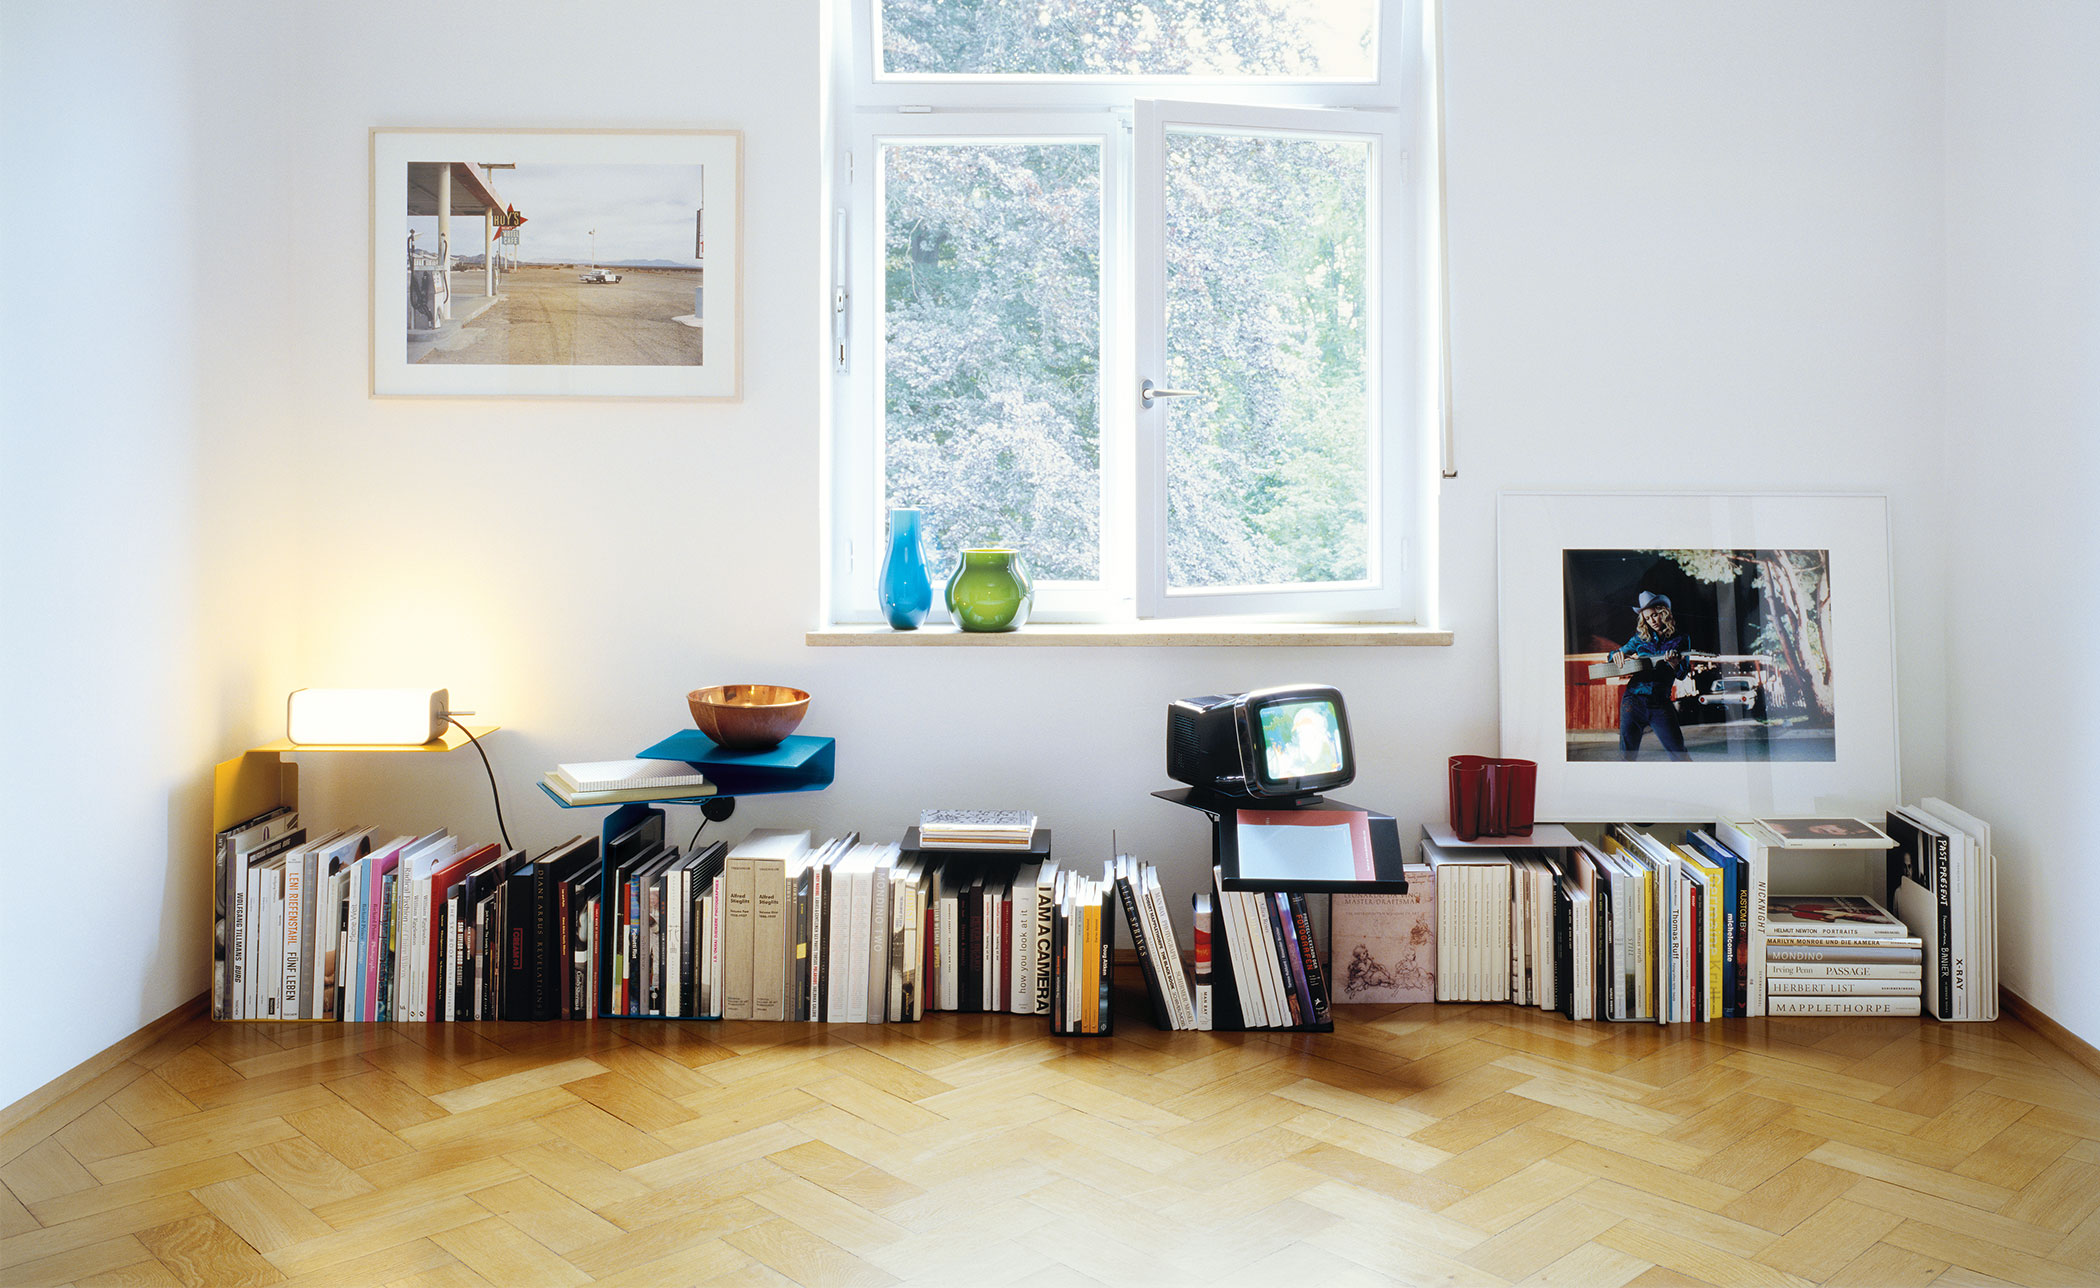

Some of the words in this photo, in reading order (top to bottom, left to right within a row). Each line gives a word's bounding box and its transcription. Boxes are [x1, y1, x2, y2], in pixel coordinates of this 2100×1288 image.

[289, 873, 299, 891] LENI
[404, 867, 412, 894] Radical
[1938, 839, 1948, 906] PAST-PRESENT
[235, 892, 244, 928] WOLFGANG
[874, 872, 886, 924] MONDINO
[1038, 894, 1051, 921] AM
[1145, 894, 1153, 913] ROBERT
[1739, 889, 1747, 922] KUSTOM
[287, 893, 299, 946] RIEFENSTAHL
[350, 904, 358, 921] Welt
[1020, 920, 1028, 929] at
[1021, 909, 1028, 917] it
[1120, 885, 1135, 913] ALICE
[1130, 917, 1147, 957] SPRINGS
[1709, 874, 1721, 956] Germaine
[349, 922, 358, 943] Meine
[1038, 924, 1050, 936] A
[1148, 912, 1163, 950] MAPPLETHORPE
[1739, 922, 1747, 932] BY
[235, 929, 243, 961] TILLMANS
[512, 931, 520, 958] CREAM
[874, 929, 884, 952] TWO
[1019, 932, 1028, 952] look
[1161, 920, 1176, 960] PHOTOGRAPH
[1295, 914, 1313, 971] FOTOGRAFEN
[286, 952, 299, 973] FÜNF
[1020, 955, 1028, 972] you
[1162, 960, 1170, 976] BLACK
[1772, 952, 1824, 961] MONDINO
[1941, 947, 1949, 978] BANIER
[1036, 938, 1050, 1012] CAMERA
[1166, 975, 1175, 990] BOOK
[1710, 960, 1721, 999] Krull
[1773, 966, 1794, 976] Irving
[1795, 966, 1813, 974] Penn
[1826, 967, 1871, 976] PASSAGE
[1955, 958, 1964, 991] X-RAY
[286, 975, 296, 1001] LEBEN
[1018, 974, 1028, 994] how
[1773, 983, 1826, 992] HERBERT
[1830, 984, 1855, 992] LIST
[1776, 1004, 1891, 1013] MAPPLETHORPE
